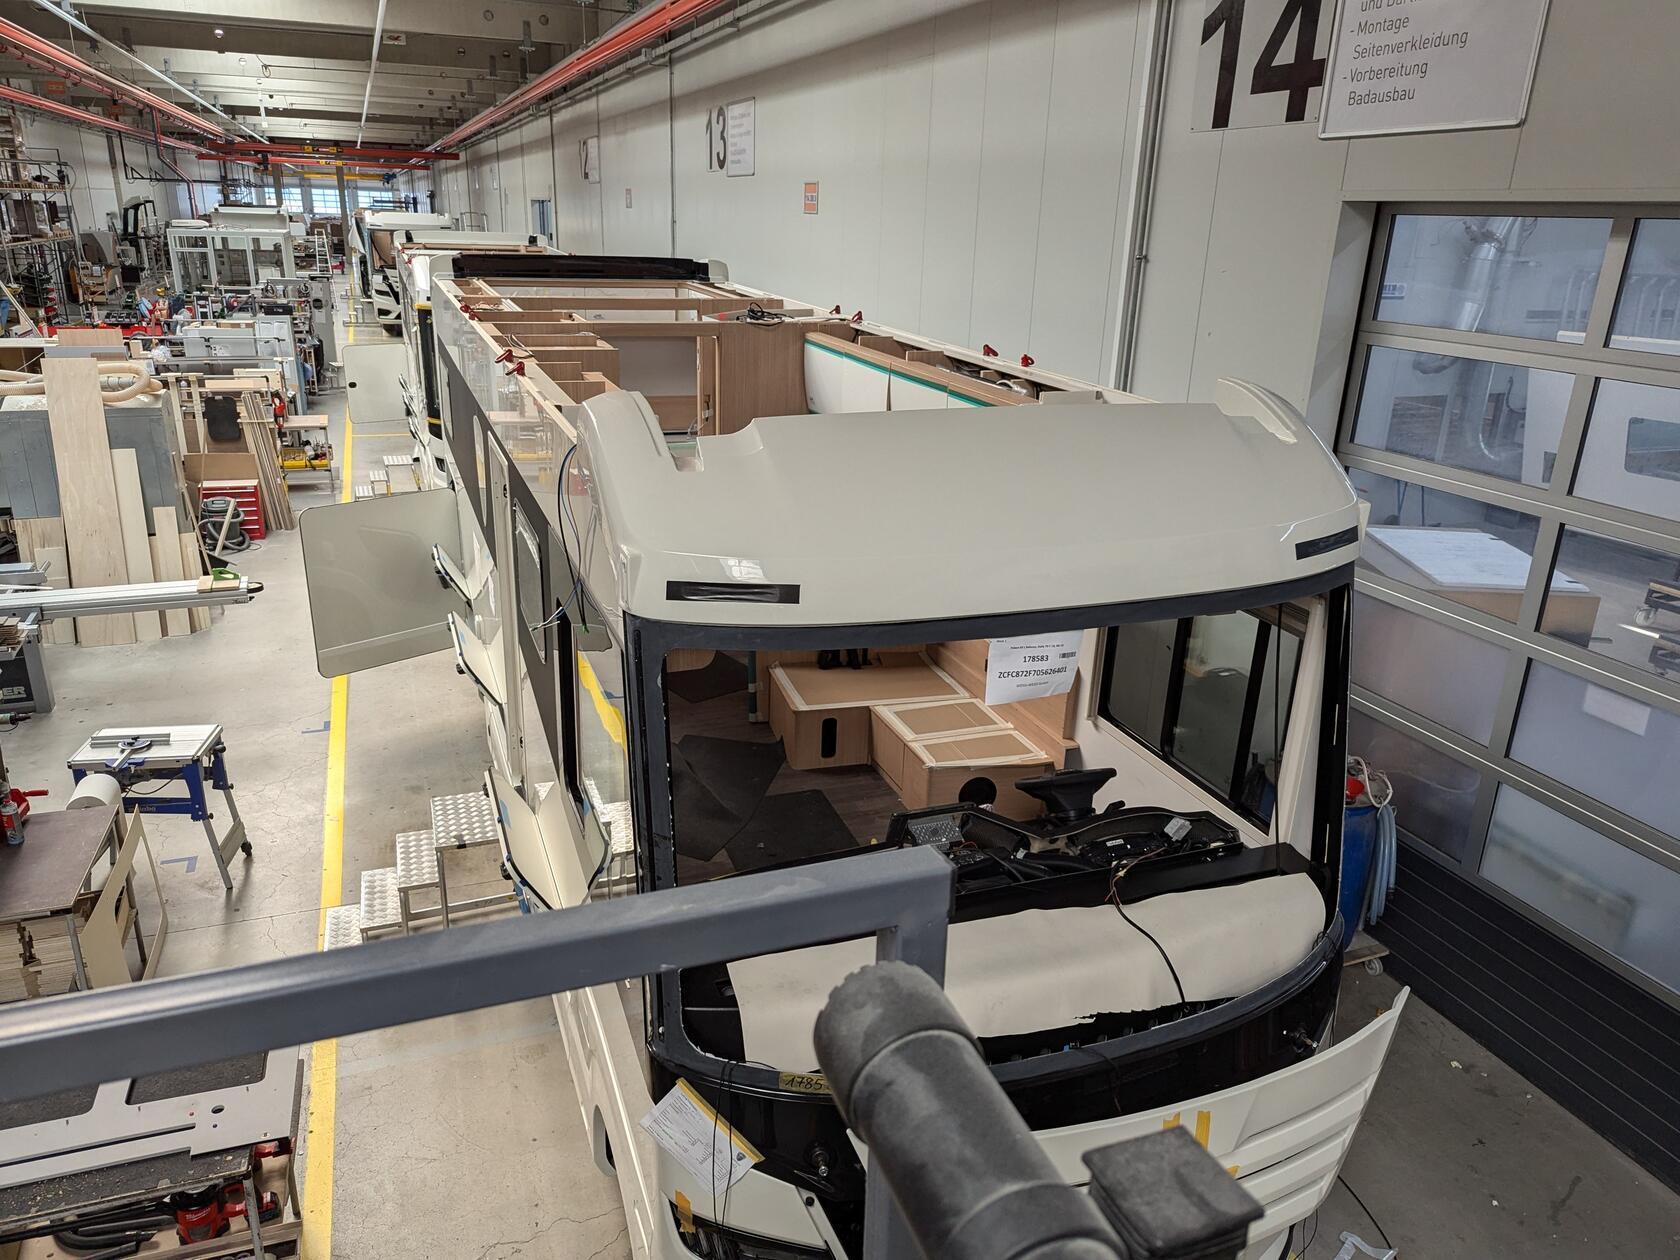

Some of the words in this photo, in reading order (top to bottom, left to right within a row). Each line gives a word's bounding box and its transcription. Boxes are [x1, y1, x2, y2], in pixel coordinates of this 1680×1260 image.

[1357, 16, 1410, 36] Montage
[1353, 31, 1469, 60] Seitenverkleidung
[1201, 0, 1326, 129] 14
[1350, 62, 1428, 82] Vorbereitung
[1347, 86, 1416, 106] Badausbau
[705, 106, 727, 170] 13
[1023, 654, 1049, 663] 178583
[785, 1075, 831, 1091] 1785
